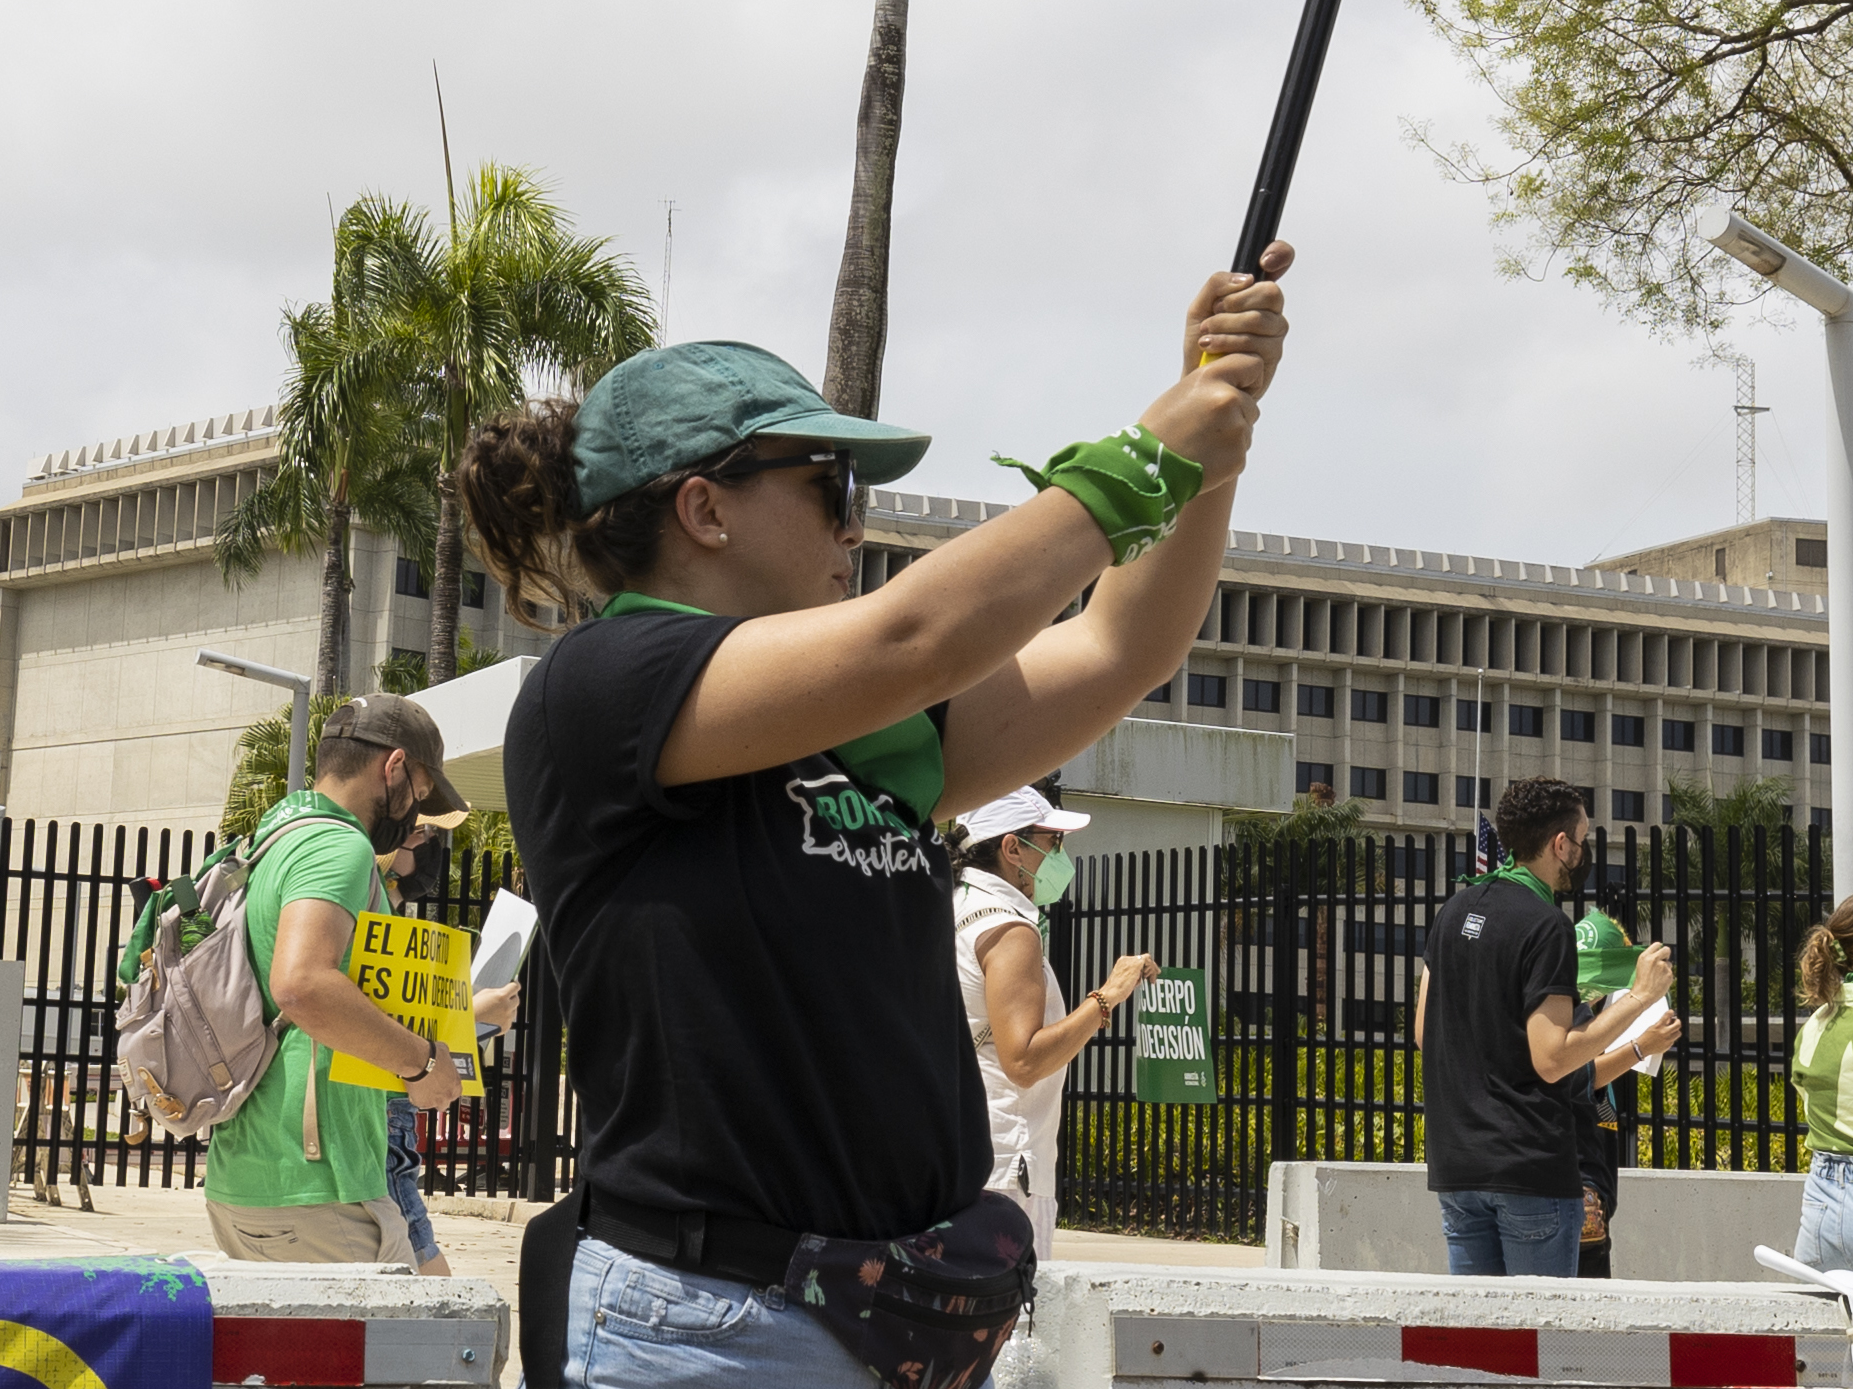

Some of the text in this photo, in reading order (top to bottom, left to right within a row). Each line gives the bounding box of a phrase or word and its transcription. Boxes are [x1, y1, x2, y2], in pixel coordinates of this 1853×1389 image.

[363, 920, 449, 965] EL ABORTO
[358, 964, 468, 1012] ES UN DERECHO
[1141, 978, 1196, 1014] CUERPO
[1141, 1015, 1206, 1060] DECISIÓN
